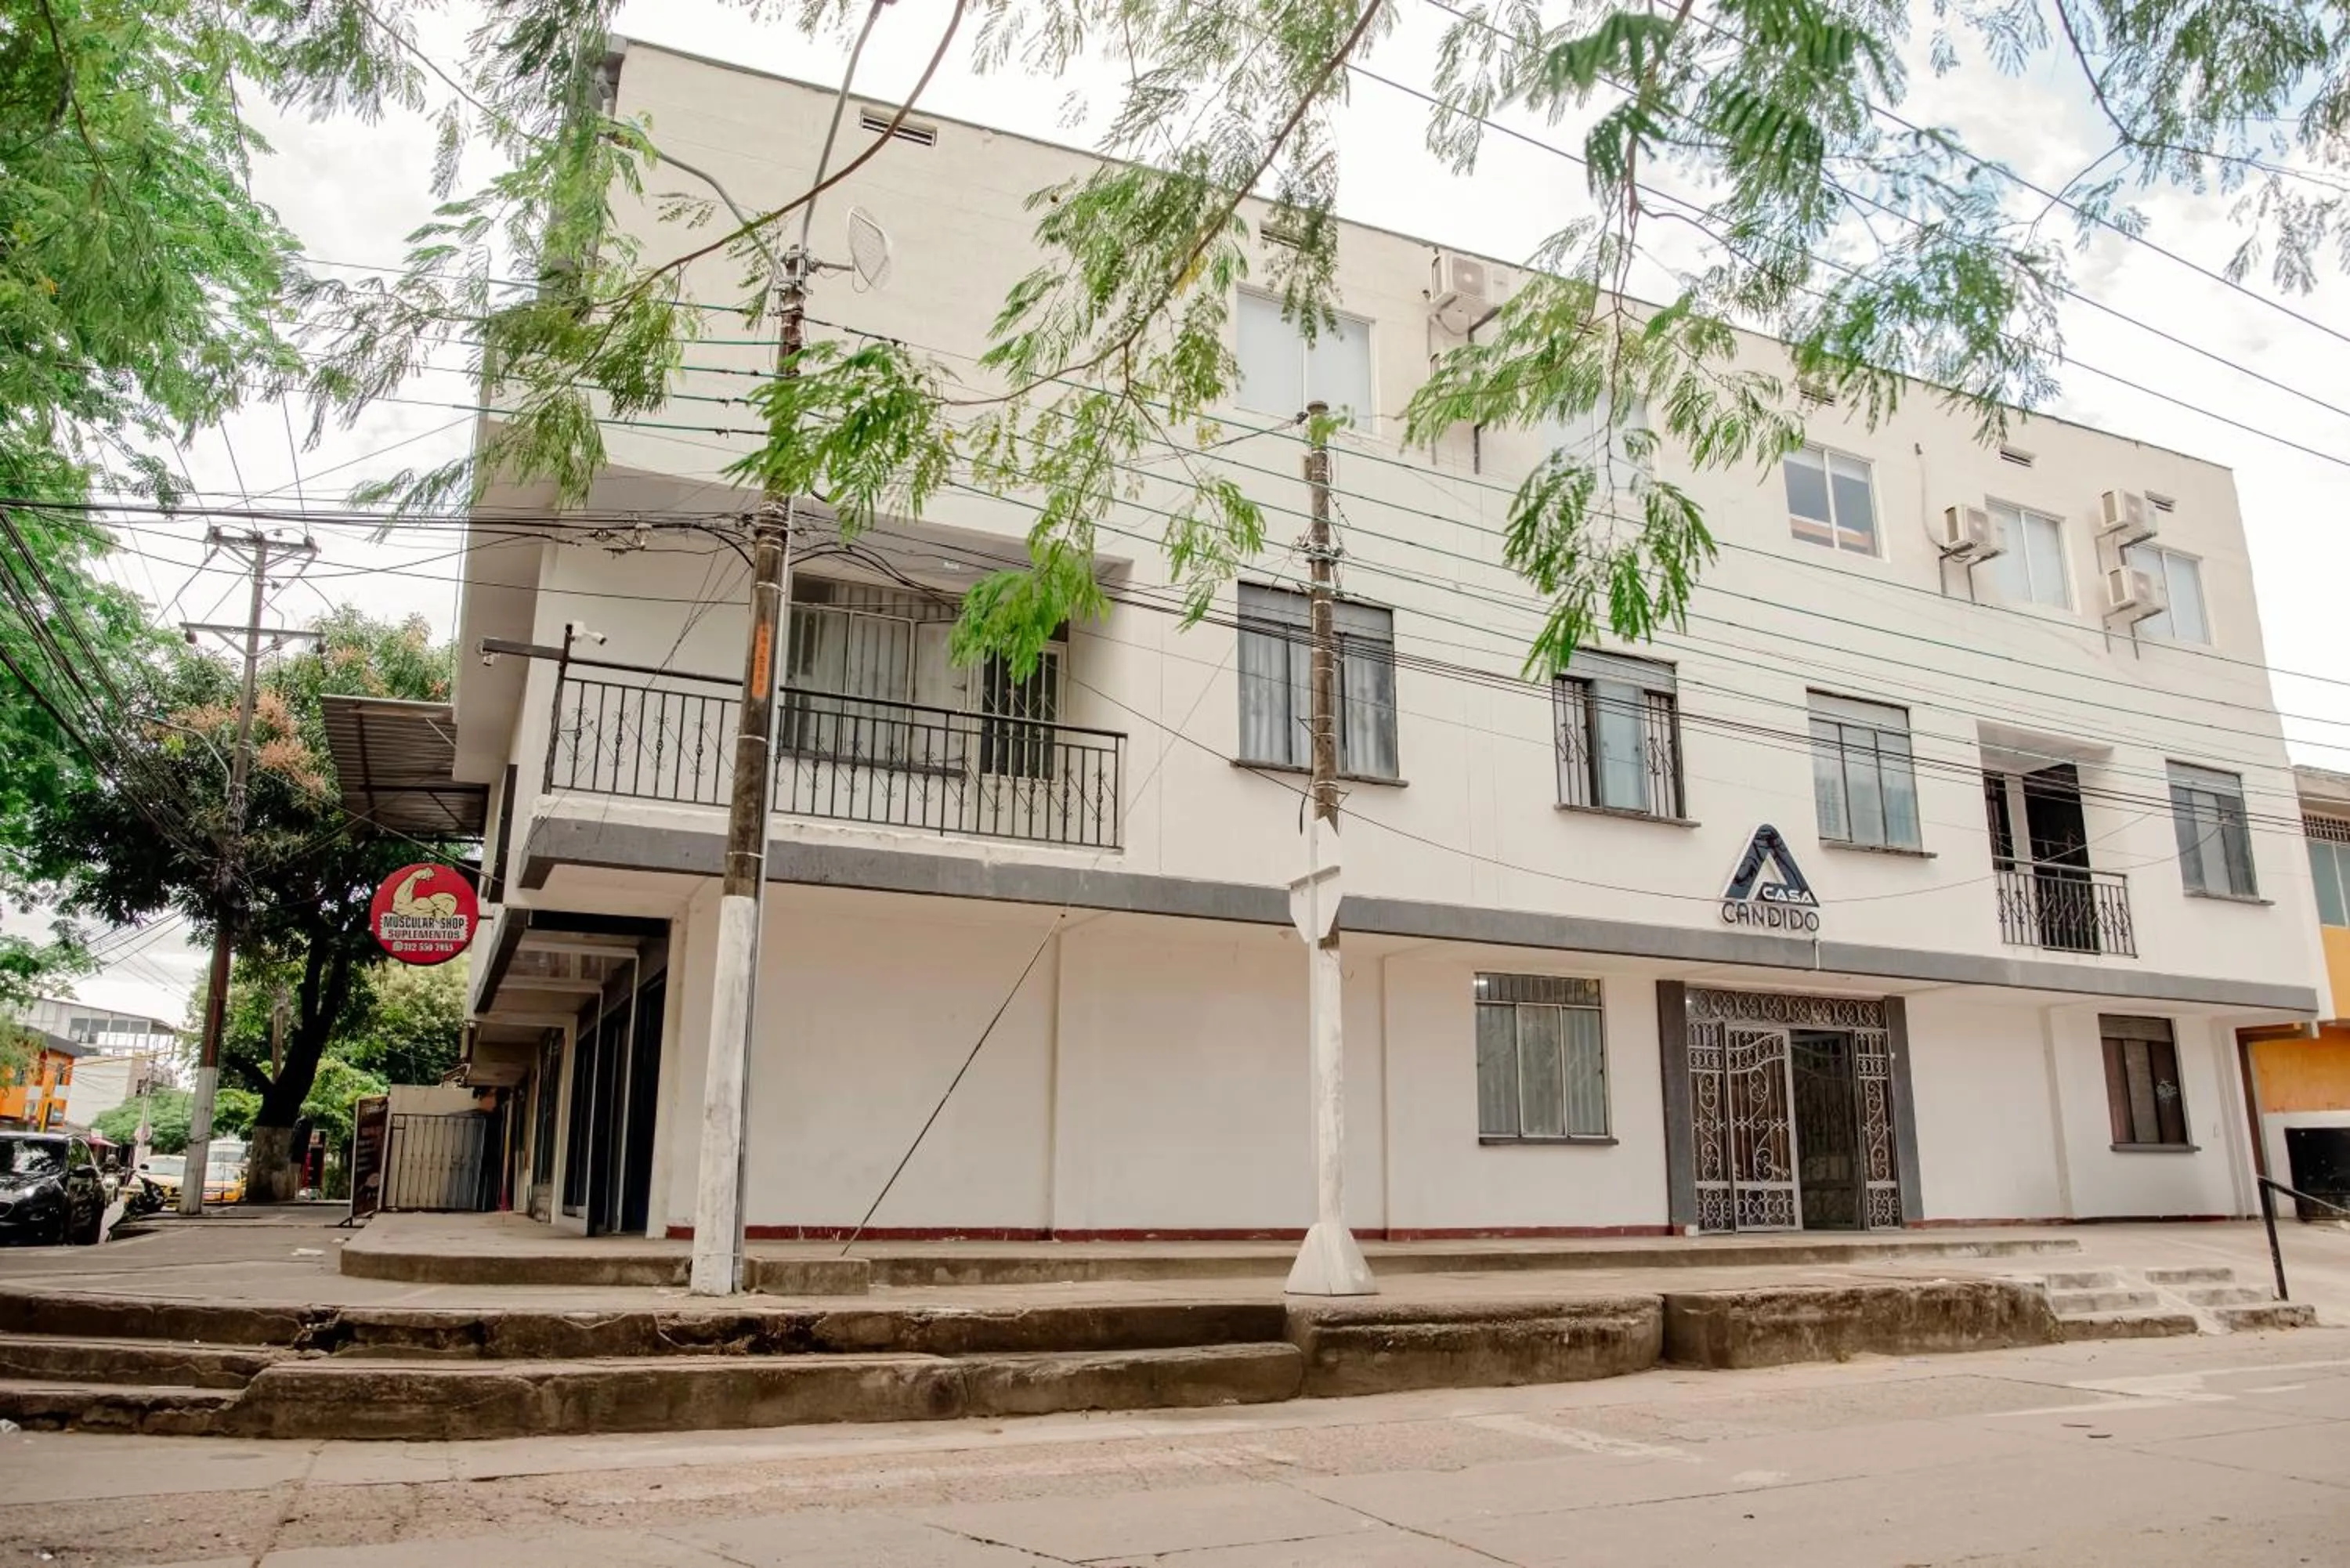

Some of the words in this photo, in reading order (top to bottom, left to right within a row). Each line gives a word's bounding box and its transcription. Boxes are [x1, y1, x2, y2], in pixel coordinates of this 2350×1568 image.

[1762, 887, 1813, 903] CASA
[384, 916, 435, 929] MUSCULAR
[440, 917, 465, 930] SHOP
[1723, 901, 1820, 932] CANDIDO
[388, 930, 460, 939] SUPLEMENTOS
